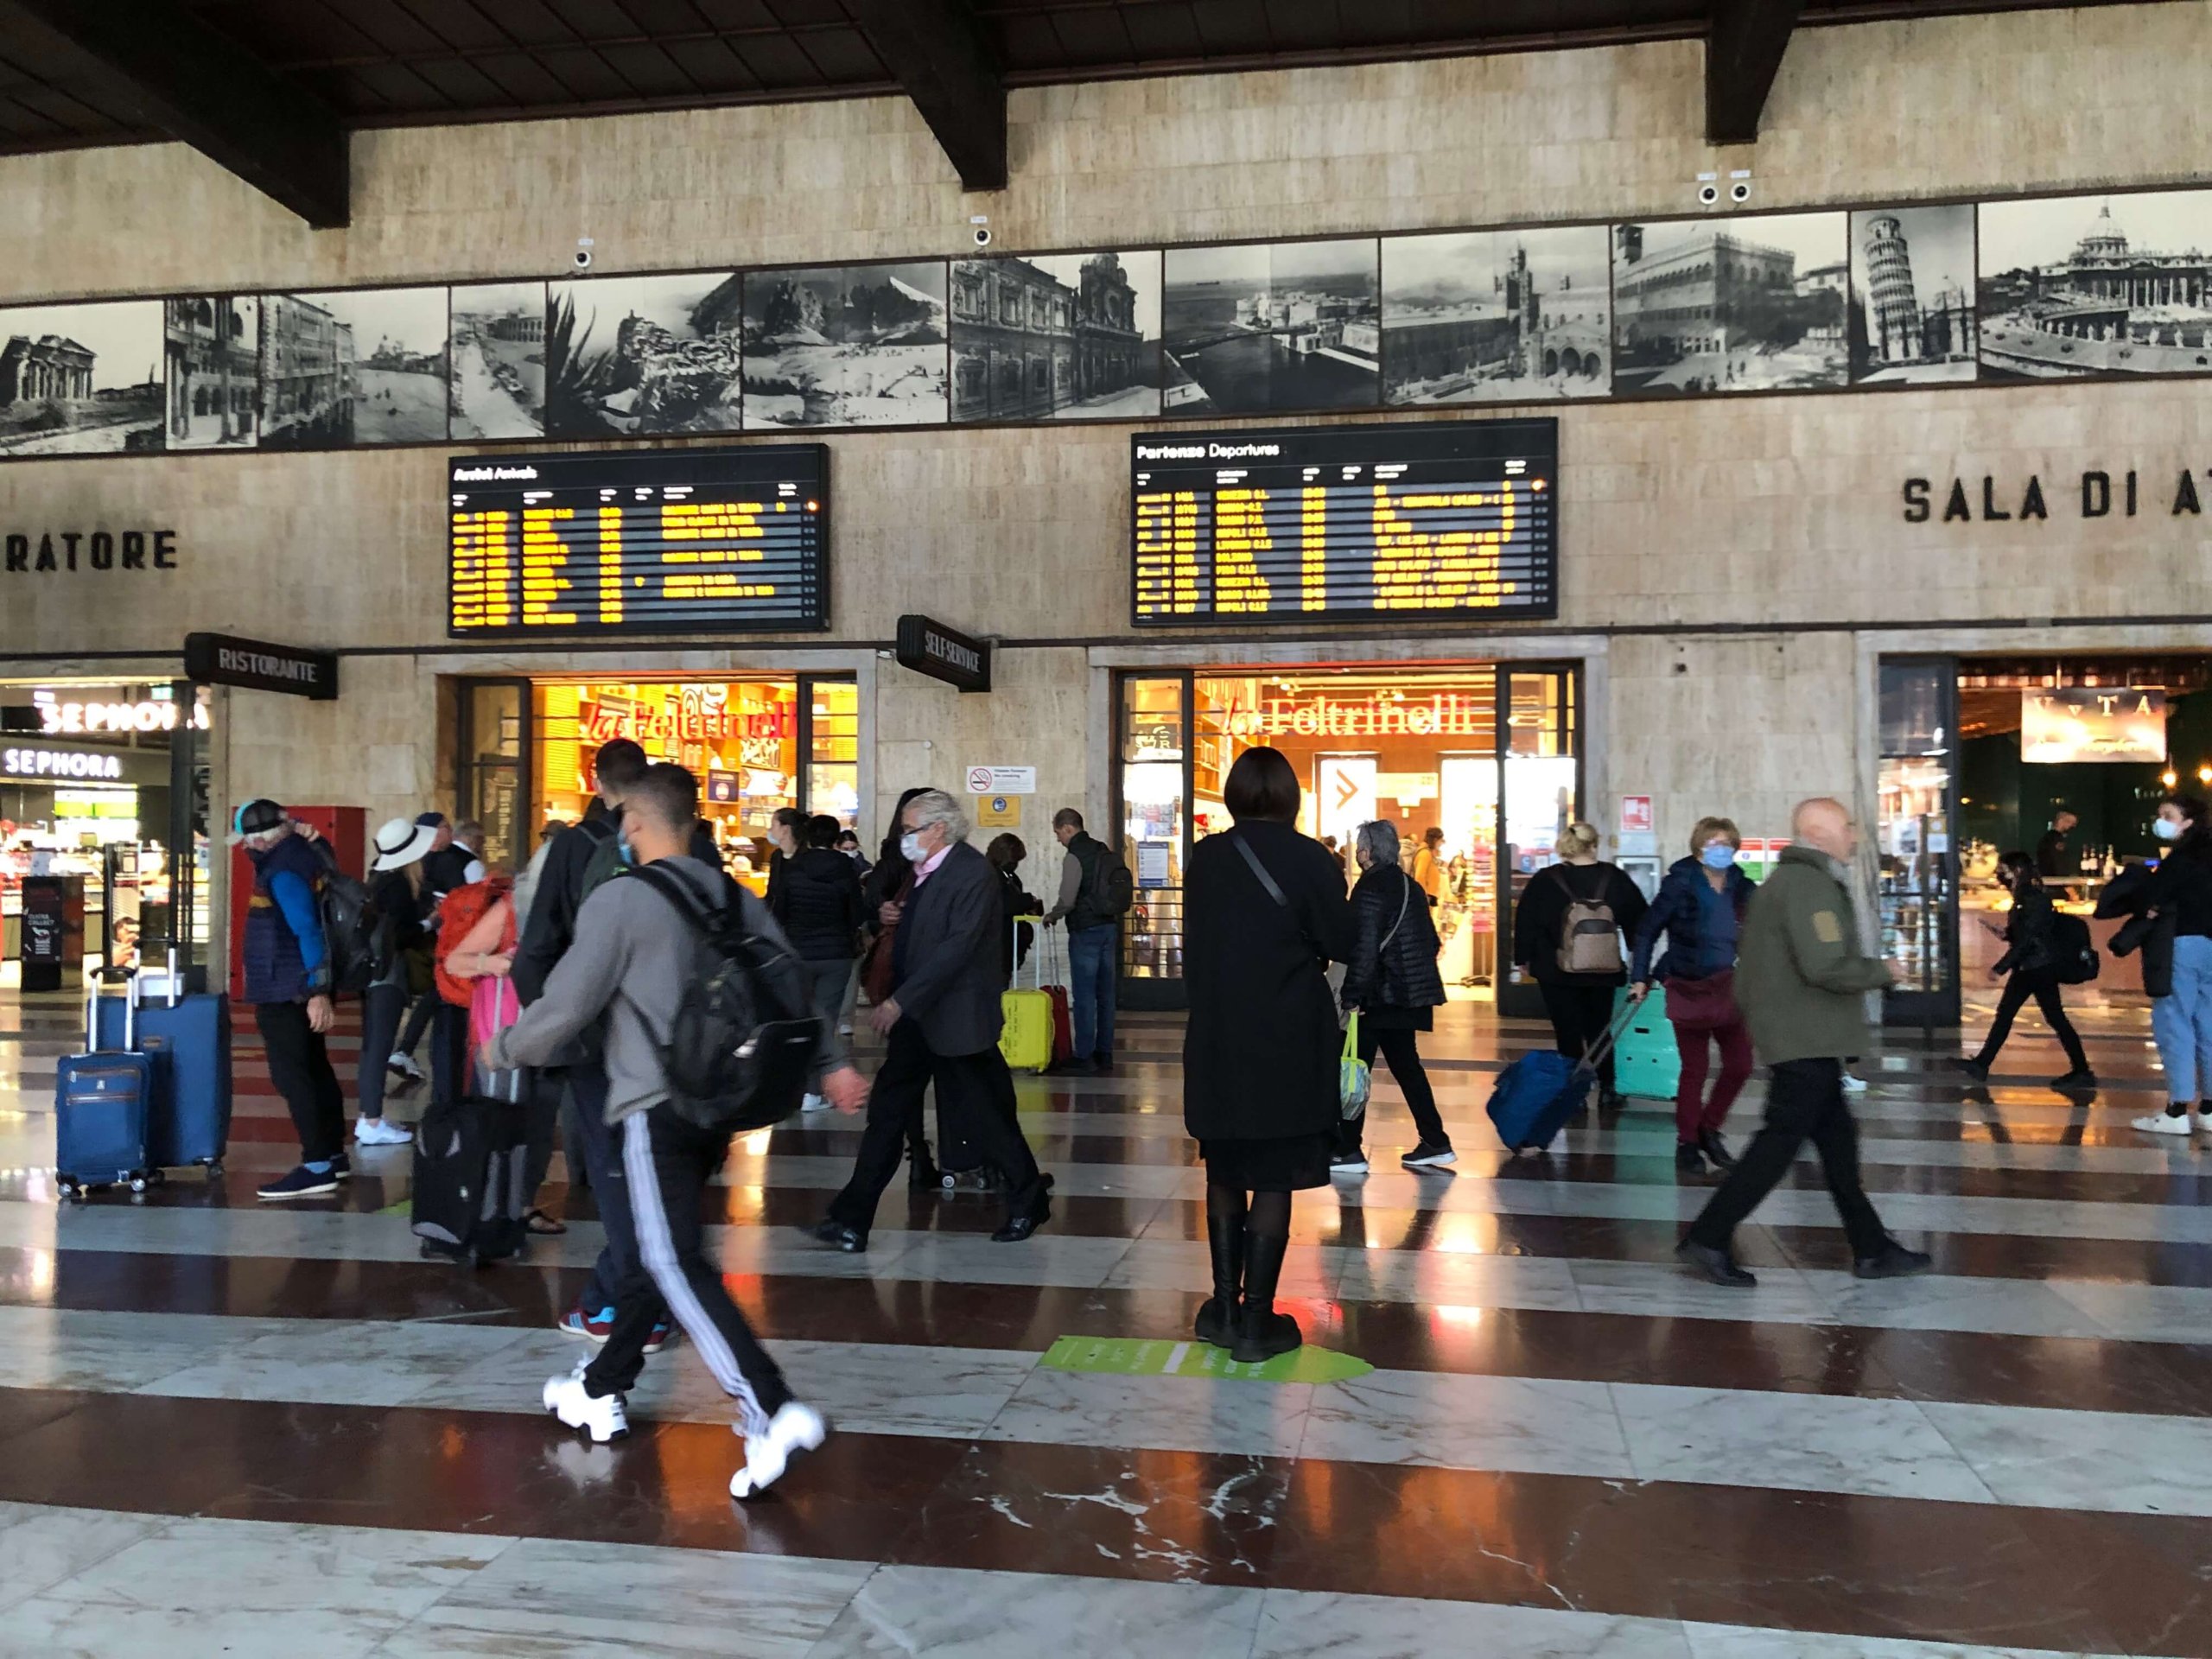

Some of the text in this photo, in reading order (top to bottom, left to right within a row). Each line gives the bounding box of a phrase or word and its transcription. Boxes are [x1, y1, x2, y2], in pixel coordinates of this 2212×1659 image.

[1209, 443, 1280, 459] Departures
[1903, 468, 2212, 523] SALA DI A
[5, 530, 178, 572] RATORE
[925, 630, 946, 658] SELF
[219, 647, 319, 683] RISTORANTE
[1268, 693, 1474, 735] Feltrinelli
[5, 748, 121, 778] SEPHORA
